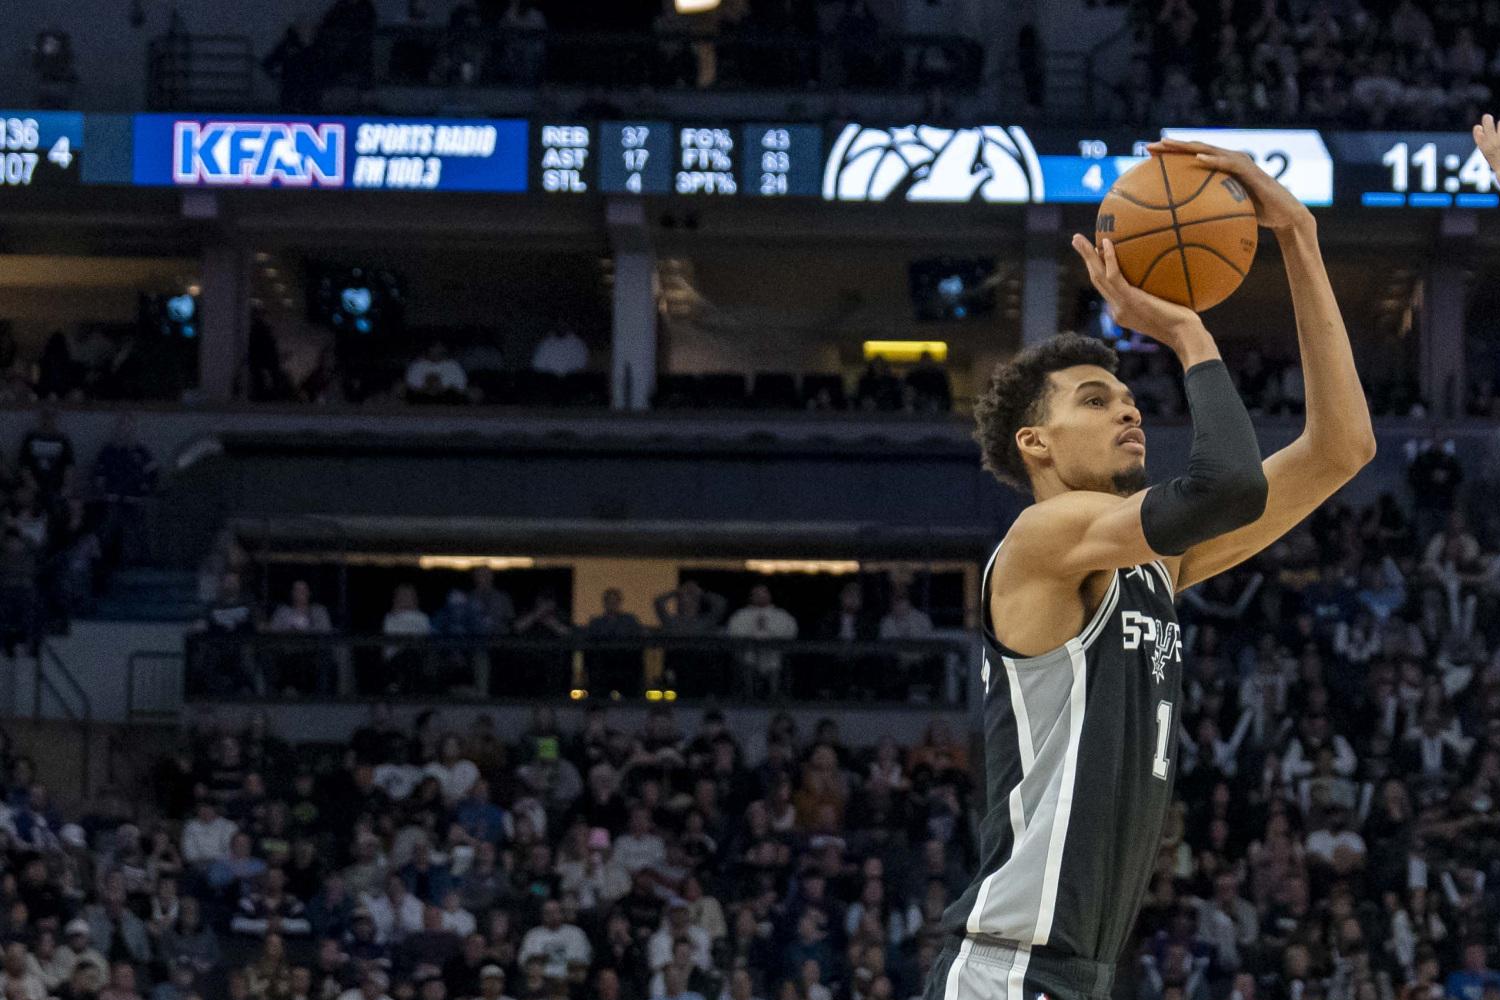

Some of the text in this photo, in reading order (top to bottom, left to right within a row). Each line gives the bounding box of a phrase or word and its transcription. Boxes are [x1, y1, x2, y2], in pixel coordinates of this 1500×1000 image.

[47, 136, 72, 169] 4
[174, 121, 345, 186] KFAN
[355, 123, 497, 157] SPORTS RADIO
[352, 156, 386, 188] FM
[1152, 700, 1174, 781] 1
